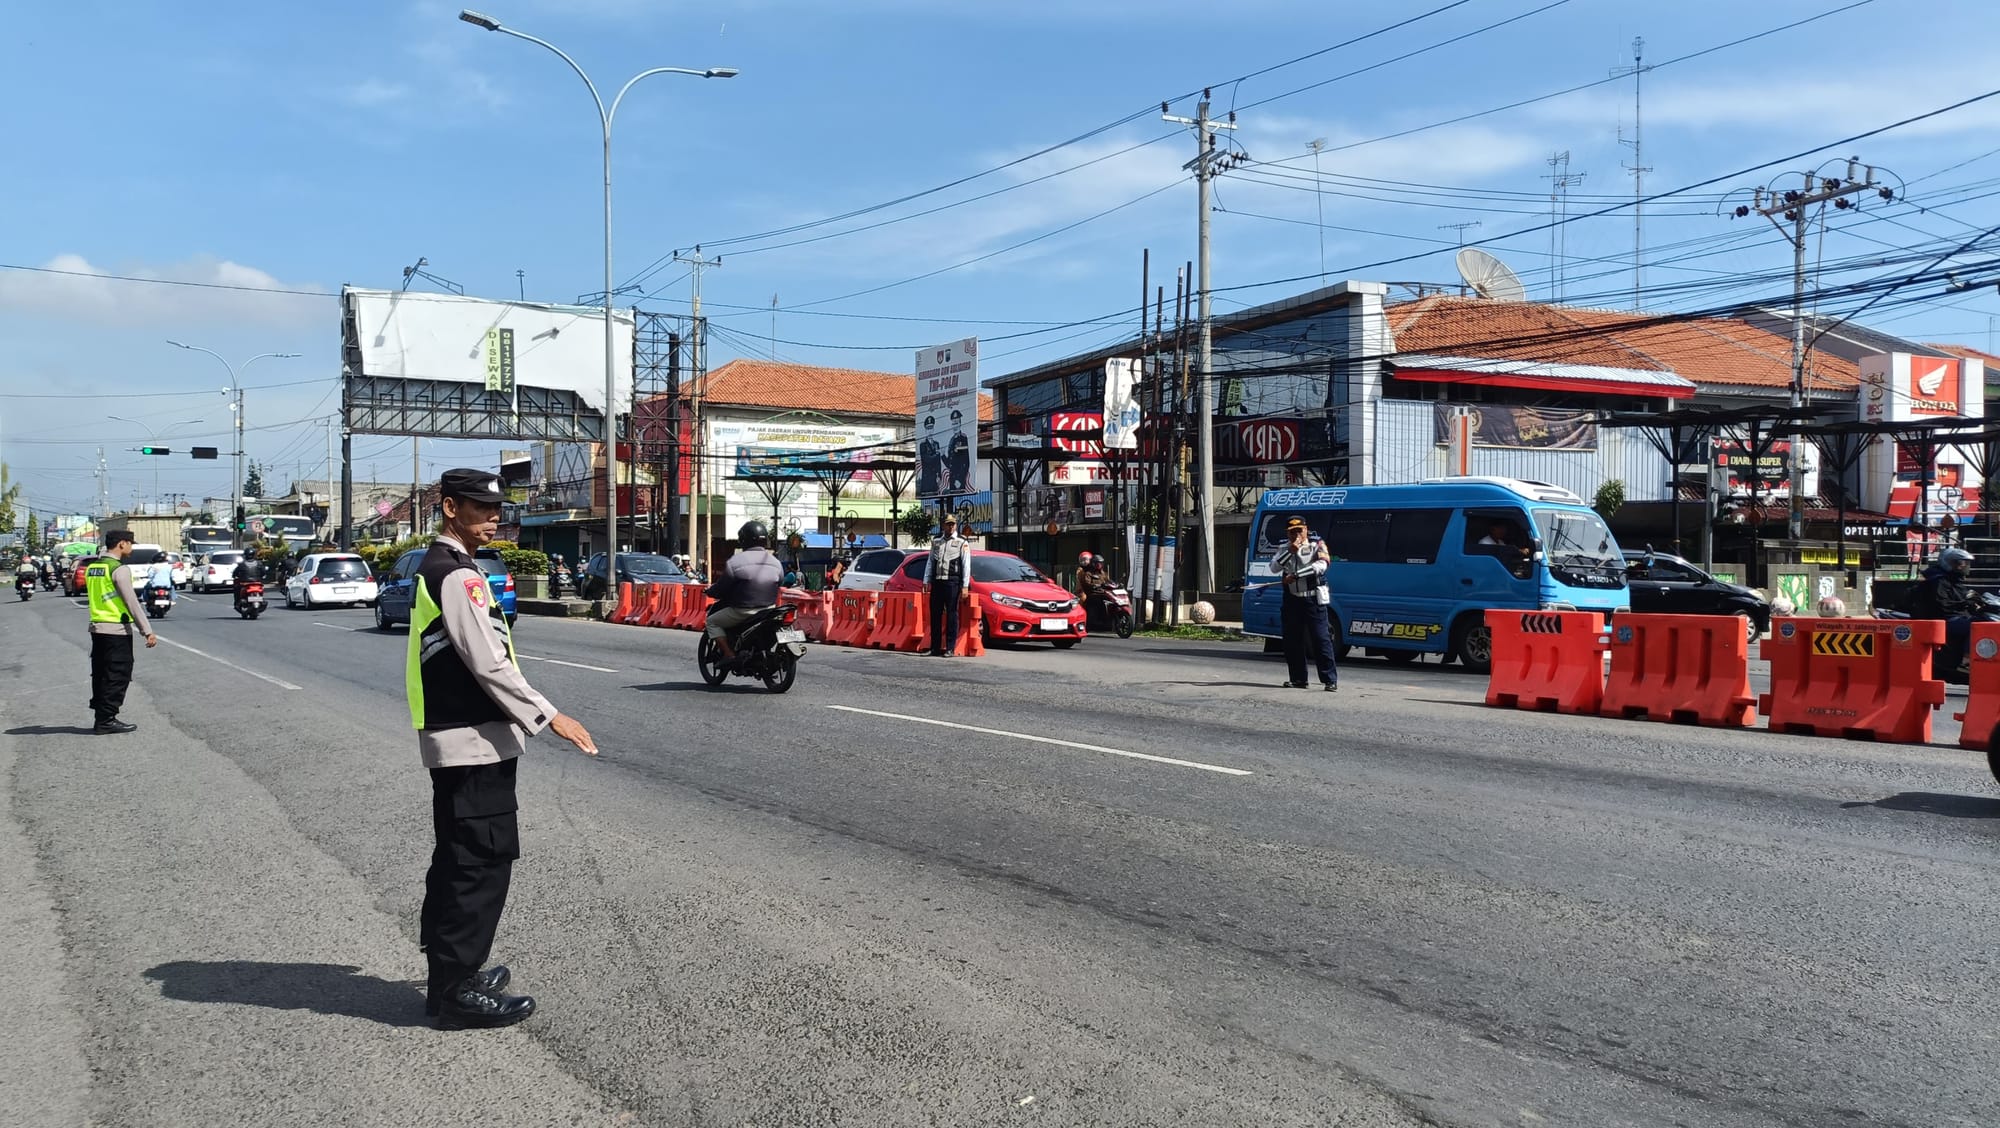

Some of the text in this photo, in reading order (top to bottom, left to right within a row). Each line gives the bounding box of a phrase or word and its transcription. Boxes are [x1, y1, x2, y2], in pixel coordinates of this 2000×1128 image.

[1911, 400, 1957, 413] HONDA
[1760, 456, 1783, 466] SUPER
[1267, 490, 1347, 506] VOYAGER
